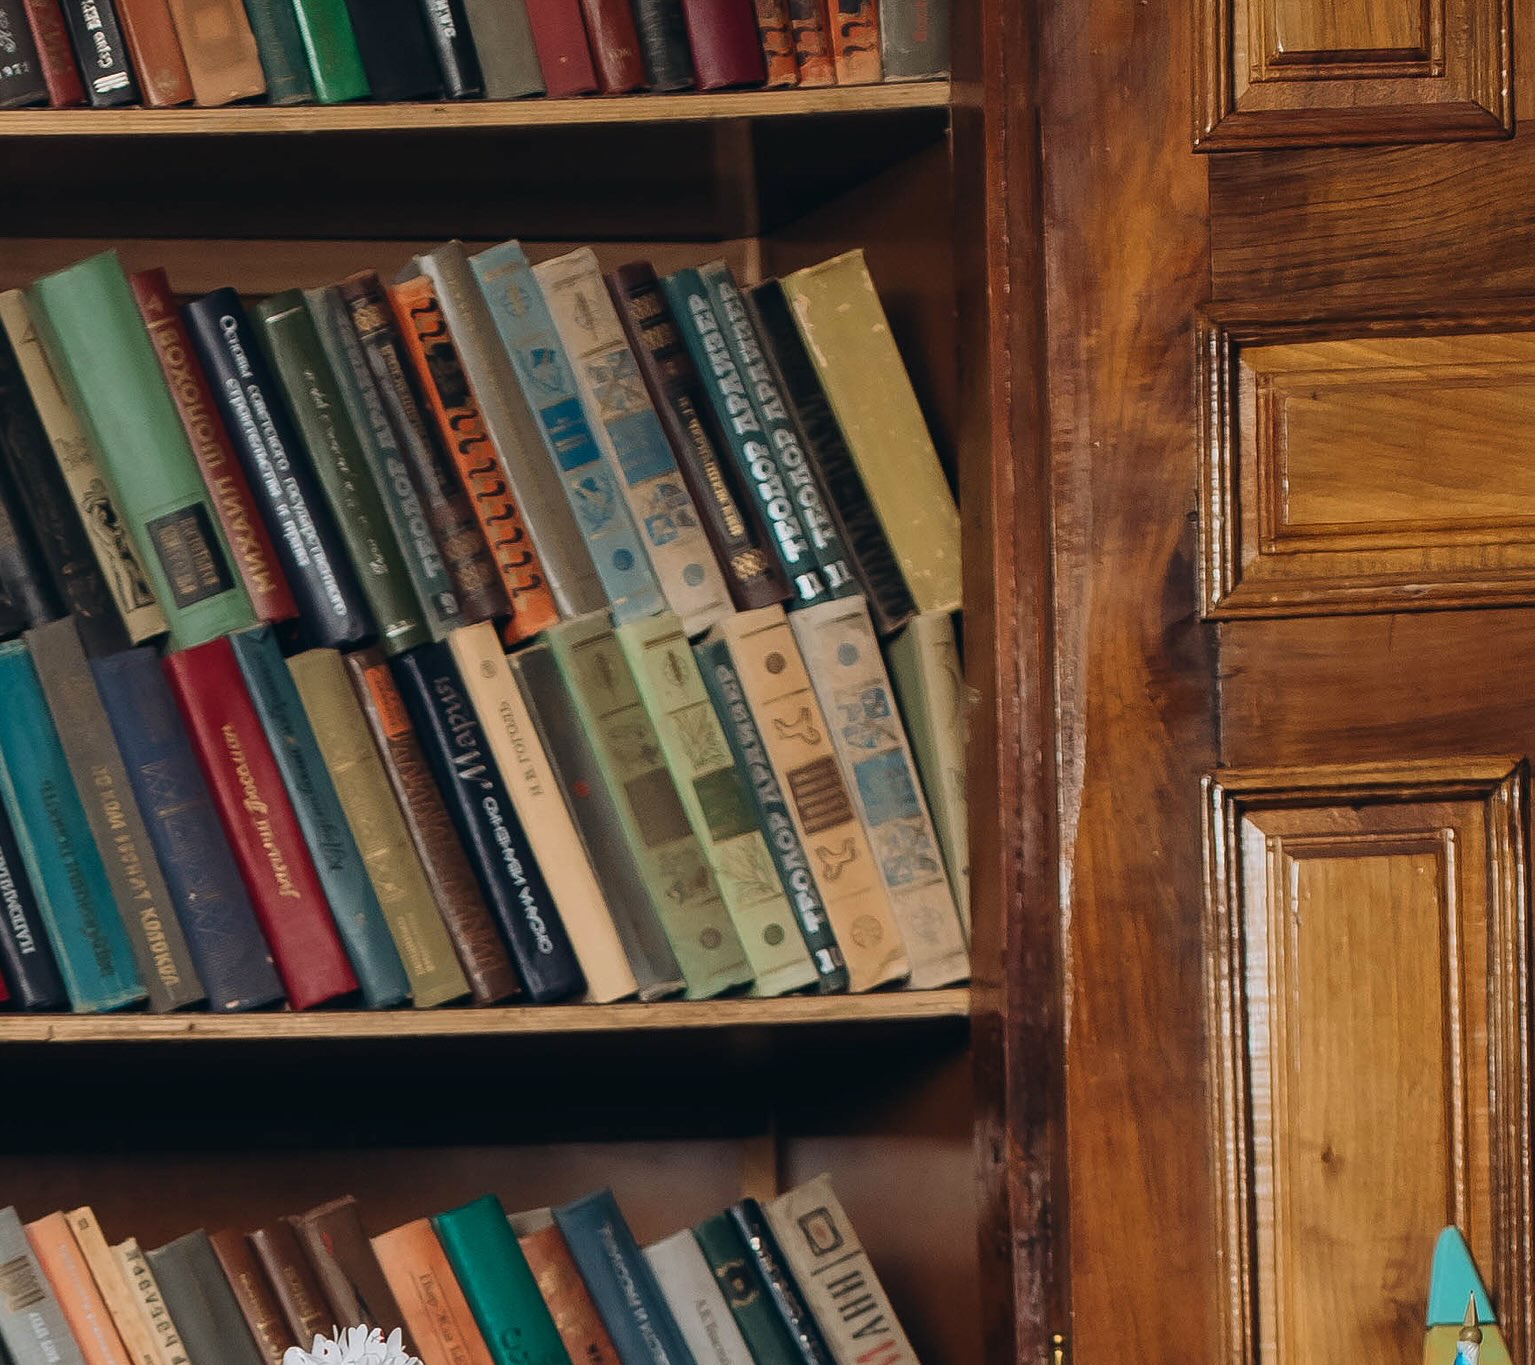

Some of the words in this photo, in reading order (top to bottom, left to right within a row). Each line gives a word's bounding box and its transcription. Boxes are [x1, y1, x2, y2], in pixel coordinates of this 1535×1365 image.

[216, 312, 258, 379] Основы
[242, 382, 293, 473] советского
[686, 288, 761, 438] ДРАЙЗЕР
[740, 433, 812, 566] ТЕОДОР
[770, 422, 838, 550] ТЕОДОР
[761, 806, 831, 935] ТЕОДОР
